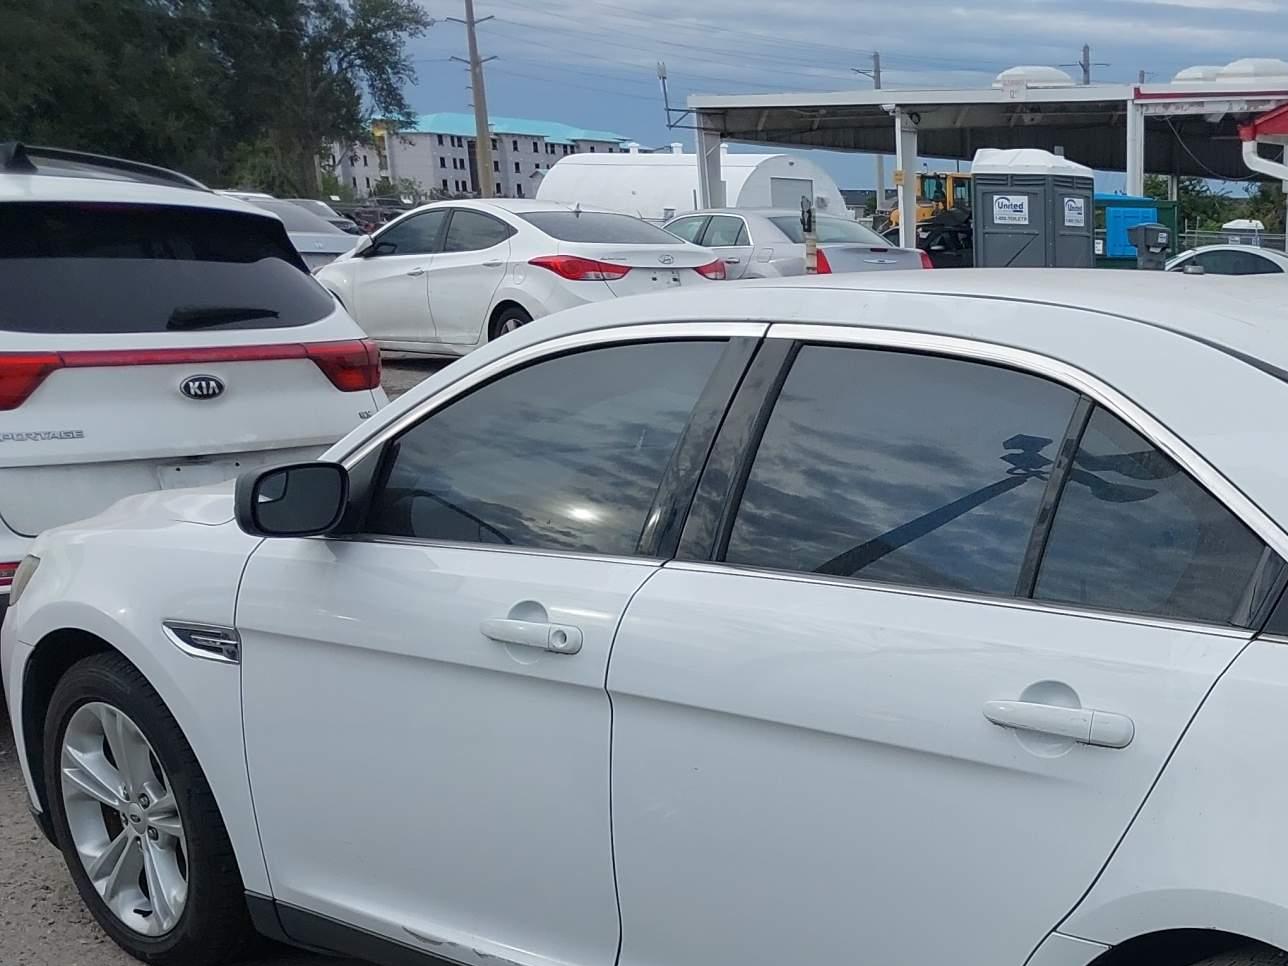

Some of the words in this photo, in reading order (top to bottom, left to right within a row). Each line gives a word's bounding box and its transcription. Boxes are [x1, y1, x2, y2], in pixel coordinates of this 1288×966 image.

[997, 201, 1024, 210] United
[188, 380, 220, 395] KIA
[0, 430, 85, 442] PORTAGE
